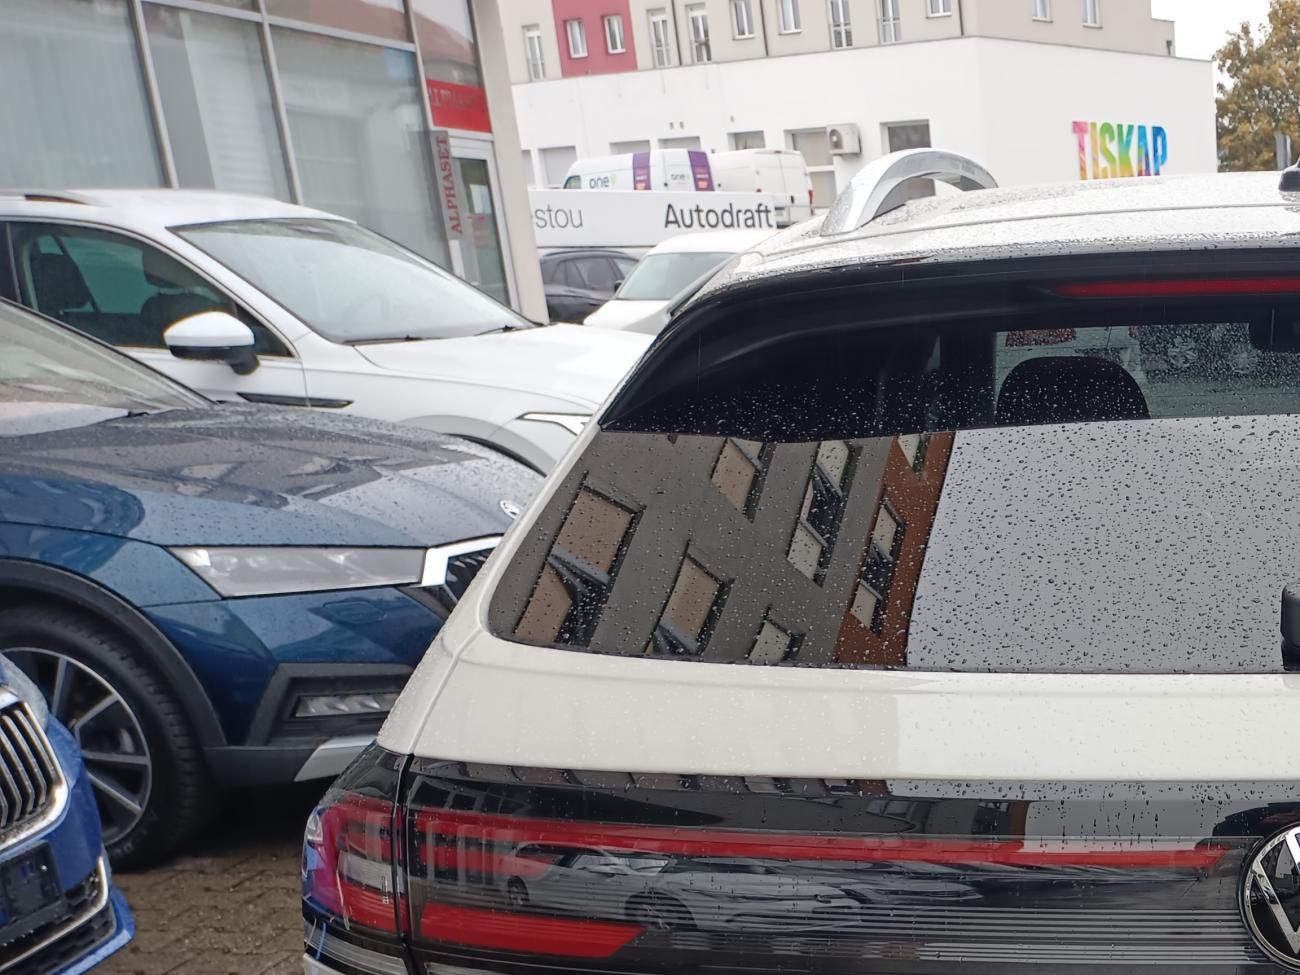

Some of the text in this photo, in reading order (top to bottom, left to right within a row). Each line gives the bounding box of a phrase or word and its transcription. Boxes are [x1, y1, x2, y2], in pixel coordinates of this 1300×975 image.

[436, 136, 462, 235] ALPHASET
[532, 204, 583, 229] stou
[664, 203, 773, 229] Autodraft
